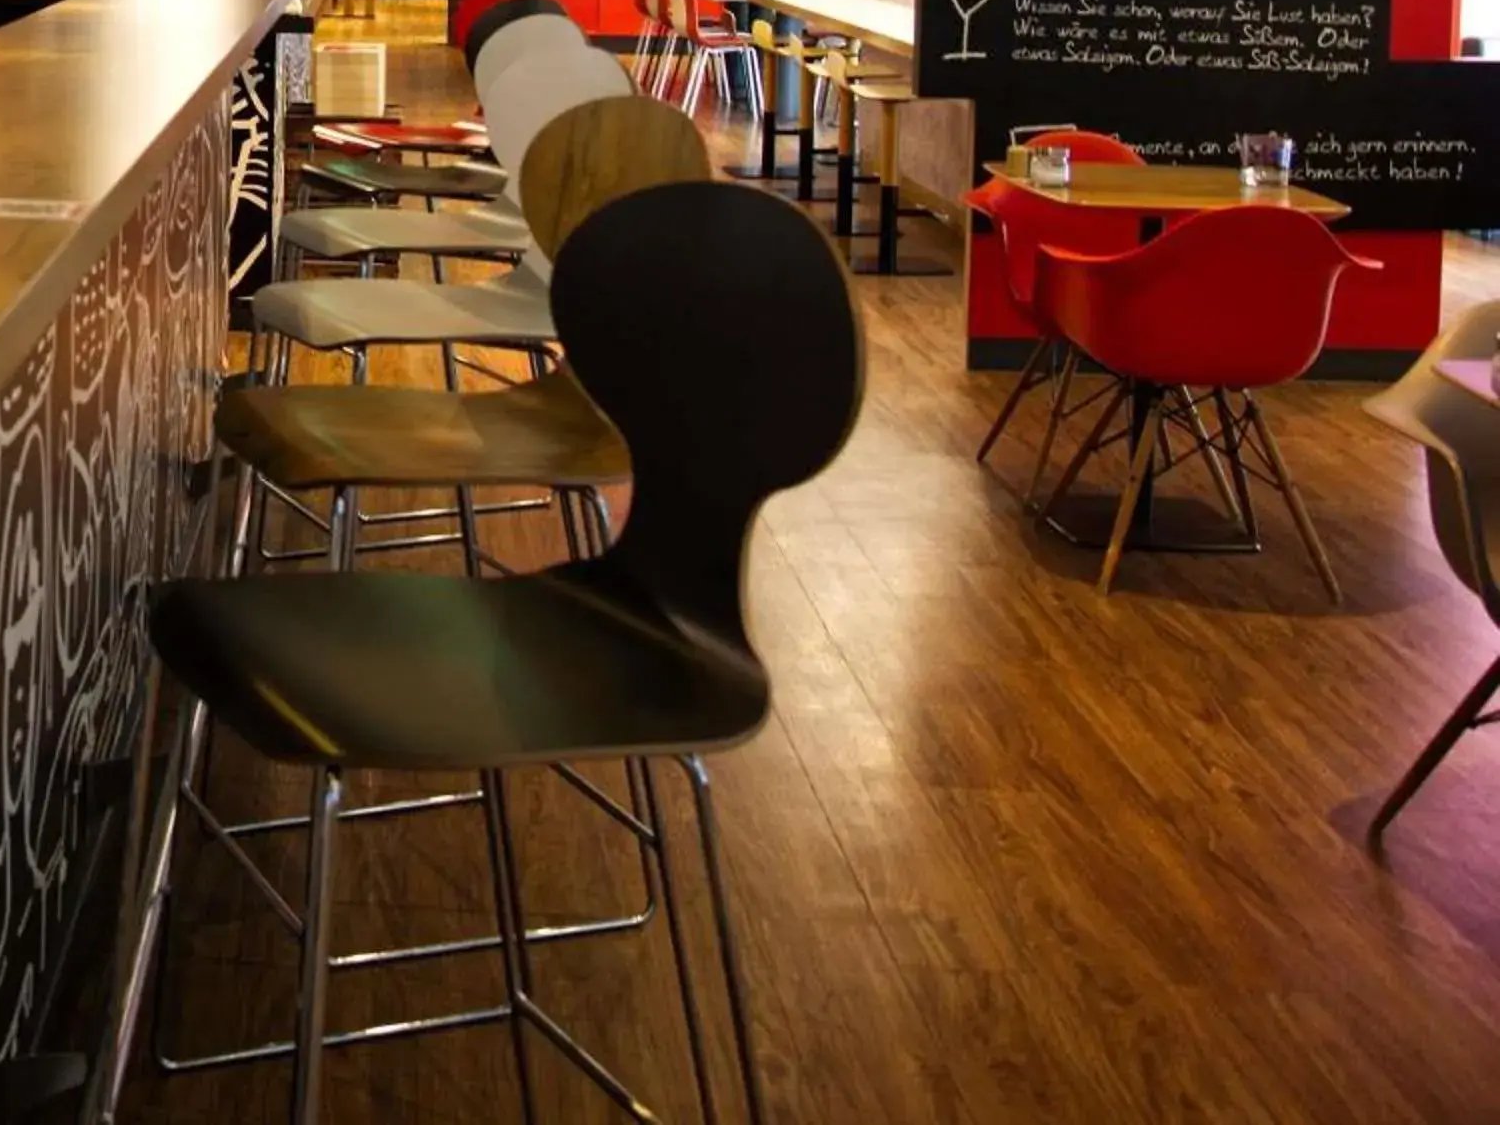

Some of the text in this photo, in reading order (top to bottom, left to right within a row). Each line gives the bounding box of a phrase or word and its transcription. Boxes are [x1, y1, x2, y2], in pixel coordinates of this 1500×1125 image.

[1169, 5, 1227, 25] worauf
[1231, 0, 1261, 22] Sie
[1267, 0, 1305, 24] Lust
[1311, 1, 1376, 29] haben?
[1013, 16, 1047, 38] Wie
[1057, 21, 1099, 40] wäre
[1109, 28, 1128, 42] es
[1137, 22, 1168, 43] mit
[1177, 30, 1230, 45] etwas
[1317, 26, 1371, 50] Oder
[1011, 46, 1059, 62] etwas
[1145, 44, 1193, 67] Oder
[1195, 52, 1245, 69] etwas
[1199, 141, 1222, 156] an
[1304, 130, 1342, 155] sich
[1345, 140, 1387, 163] gern
[1393, 130, 1477, 154] erinnern.
